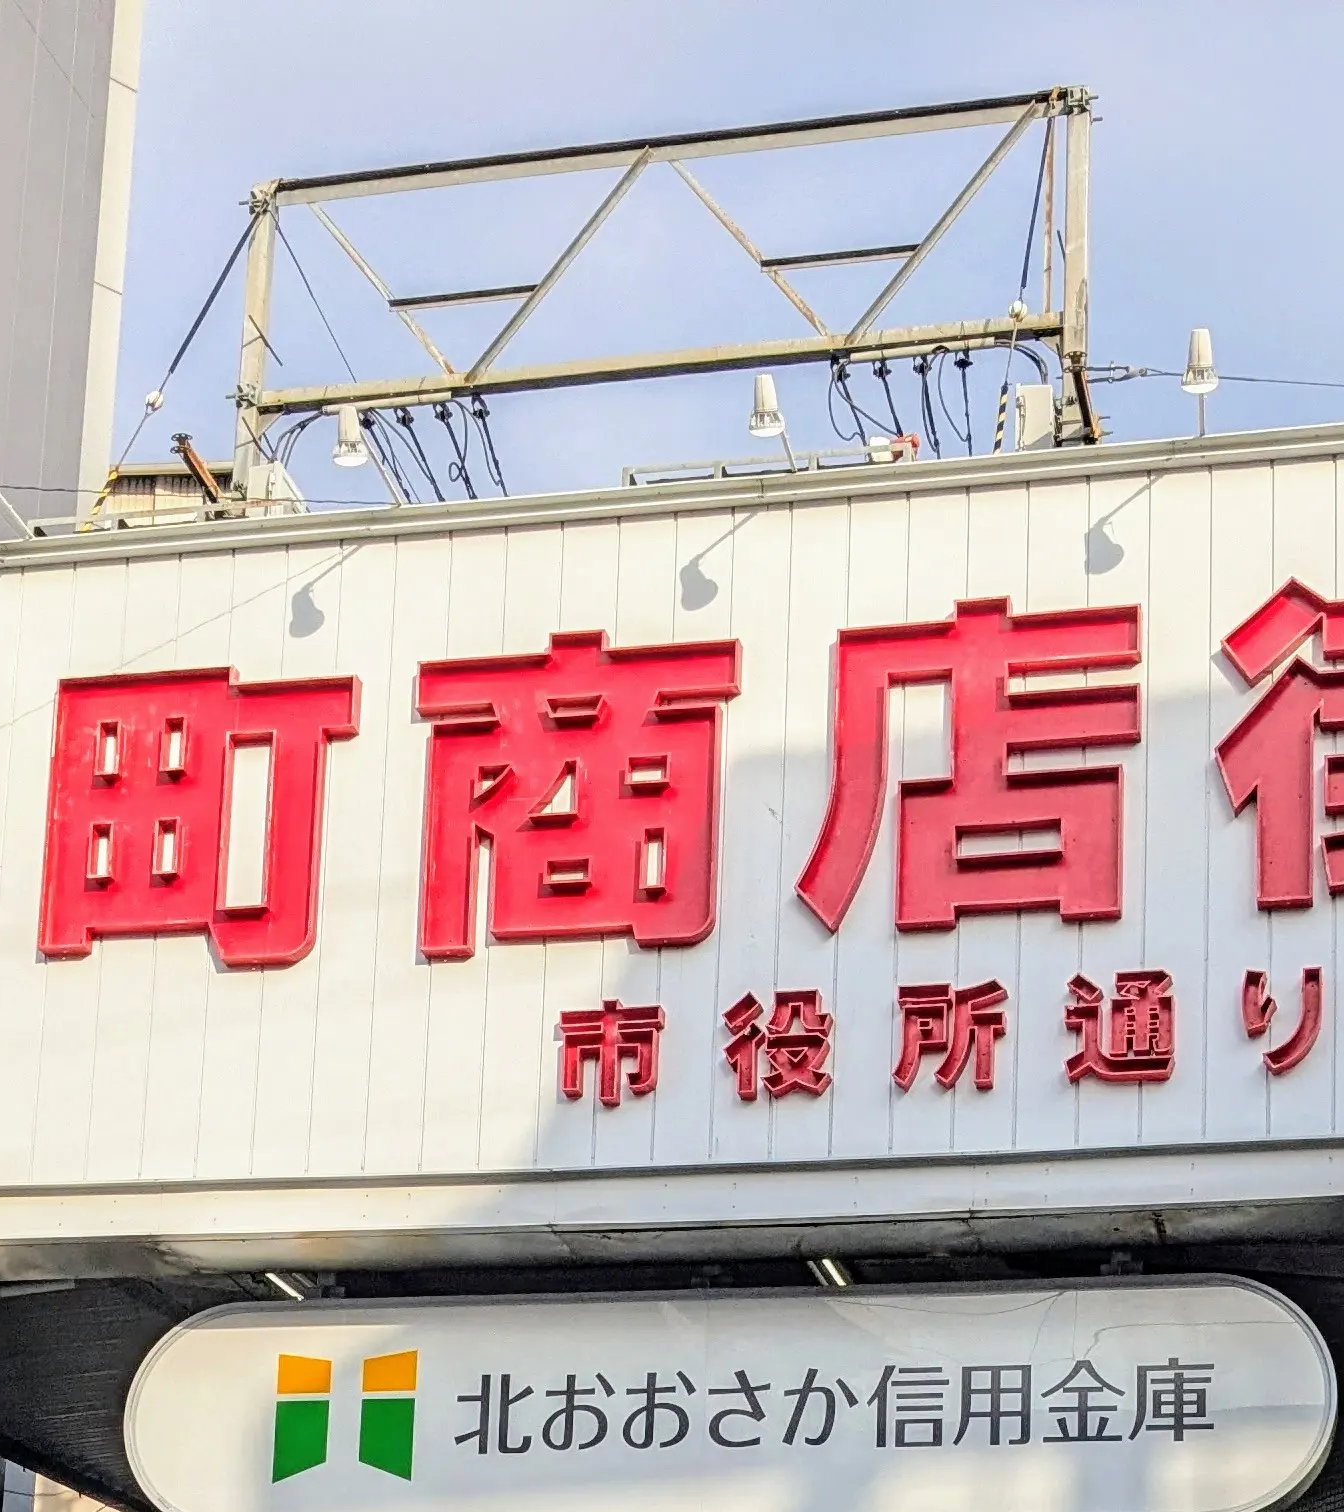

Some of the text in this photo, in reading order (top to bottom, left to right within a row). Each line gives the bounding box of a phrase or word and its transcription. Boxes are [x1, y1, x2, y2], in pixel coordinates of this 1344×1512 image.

[559, 966, 1323, 1107] 市役所通り
[454, 1356, 1215, 1456] 北おおさか信用金庫
